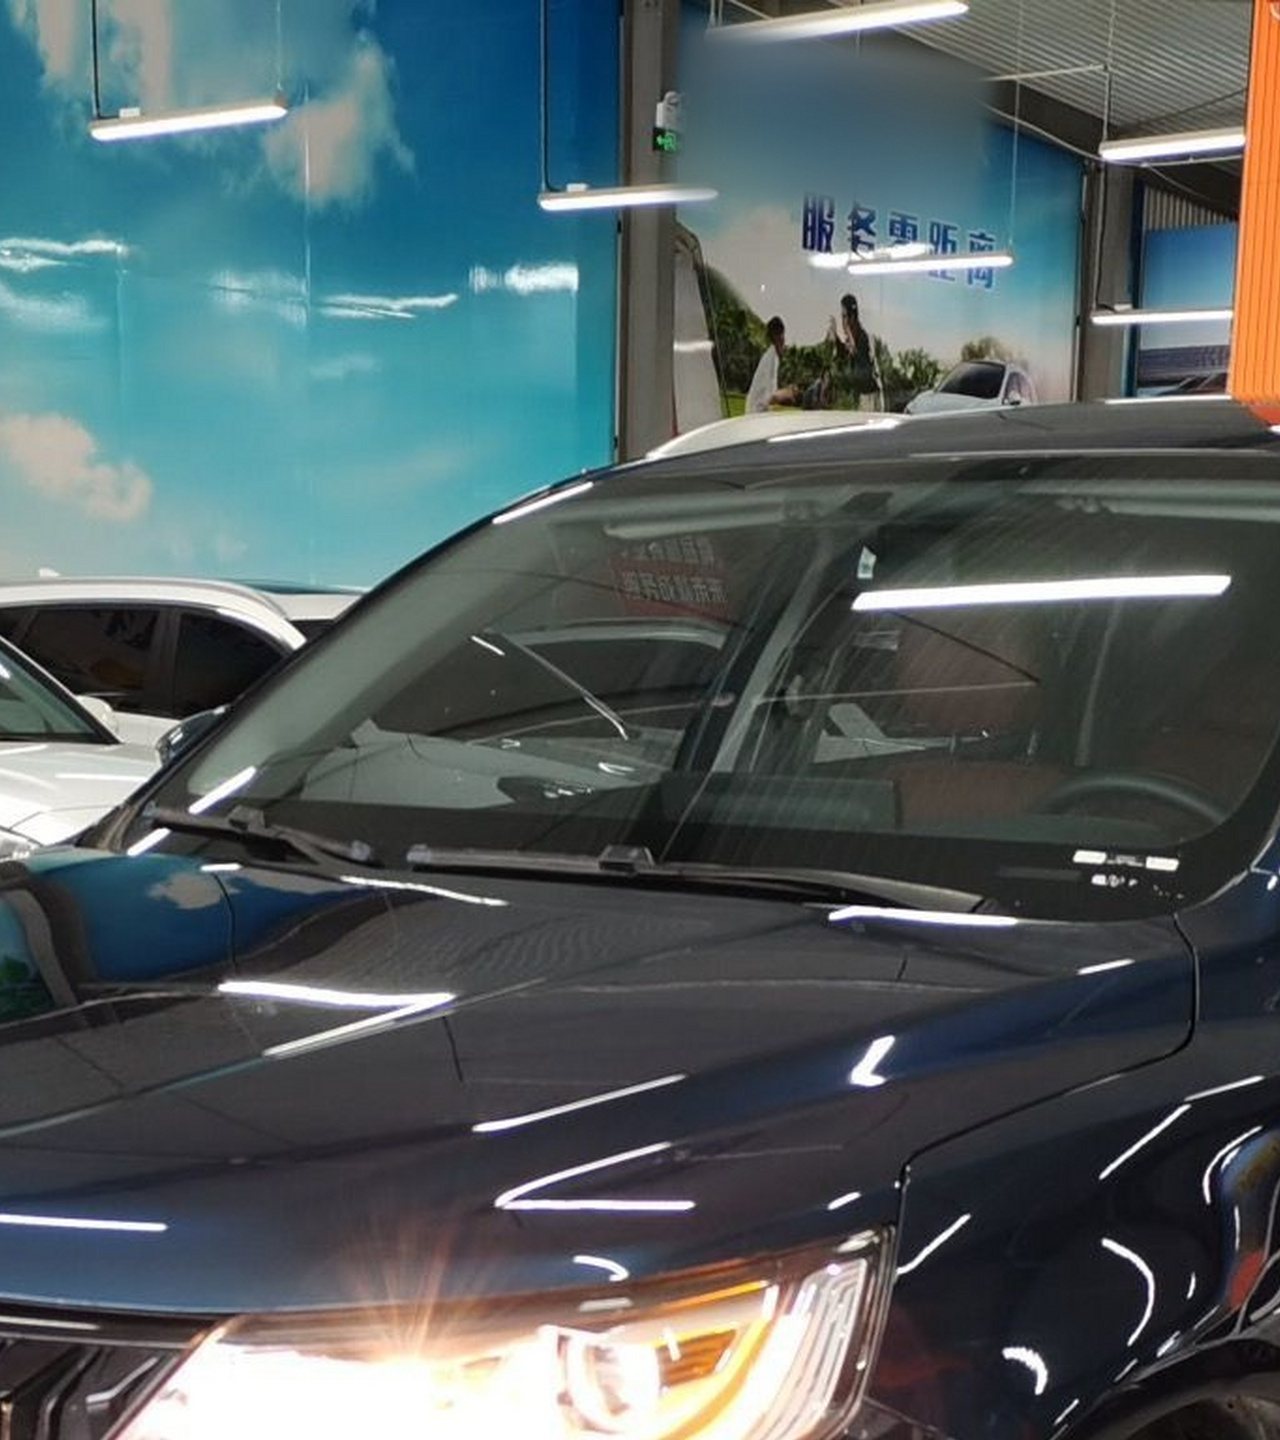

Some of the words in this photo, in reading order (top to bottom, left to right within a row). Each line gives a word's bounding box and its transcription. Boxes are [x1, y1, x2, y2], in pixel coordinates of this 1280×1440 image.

[801, 194, 996, 290] 服务零距离
